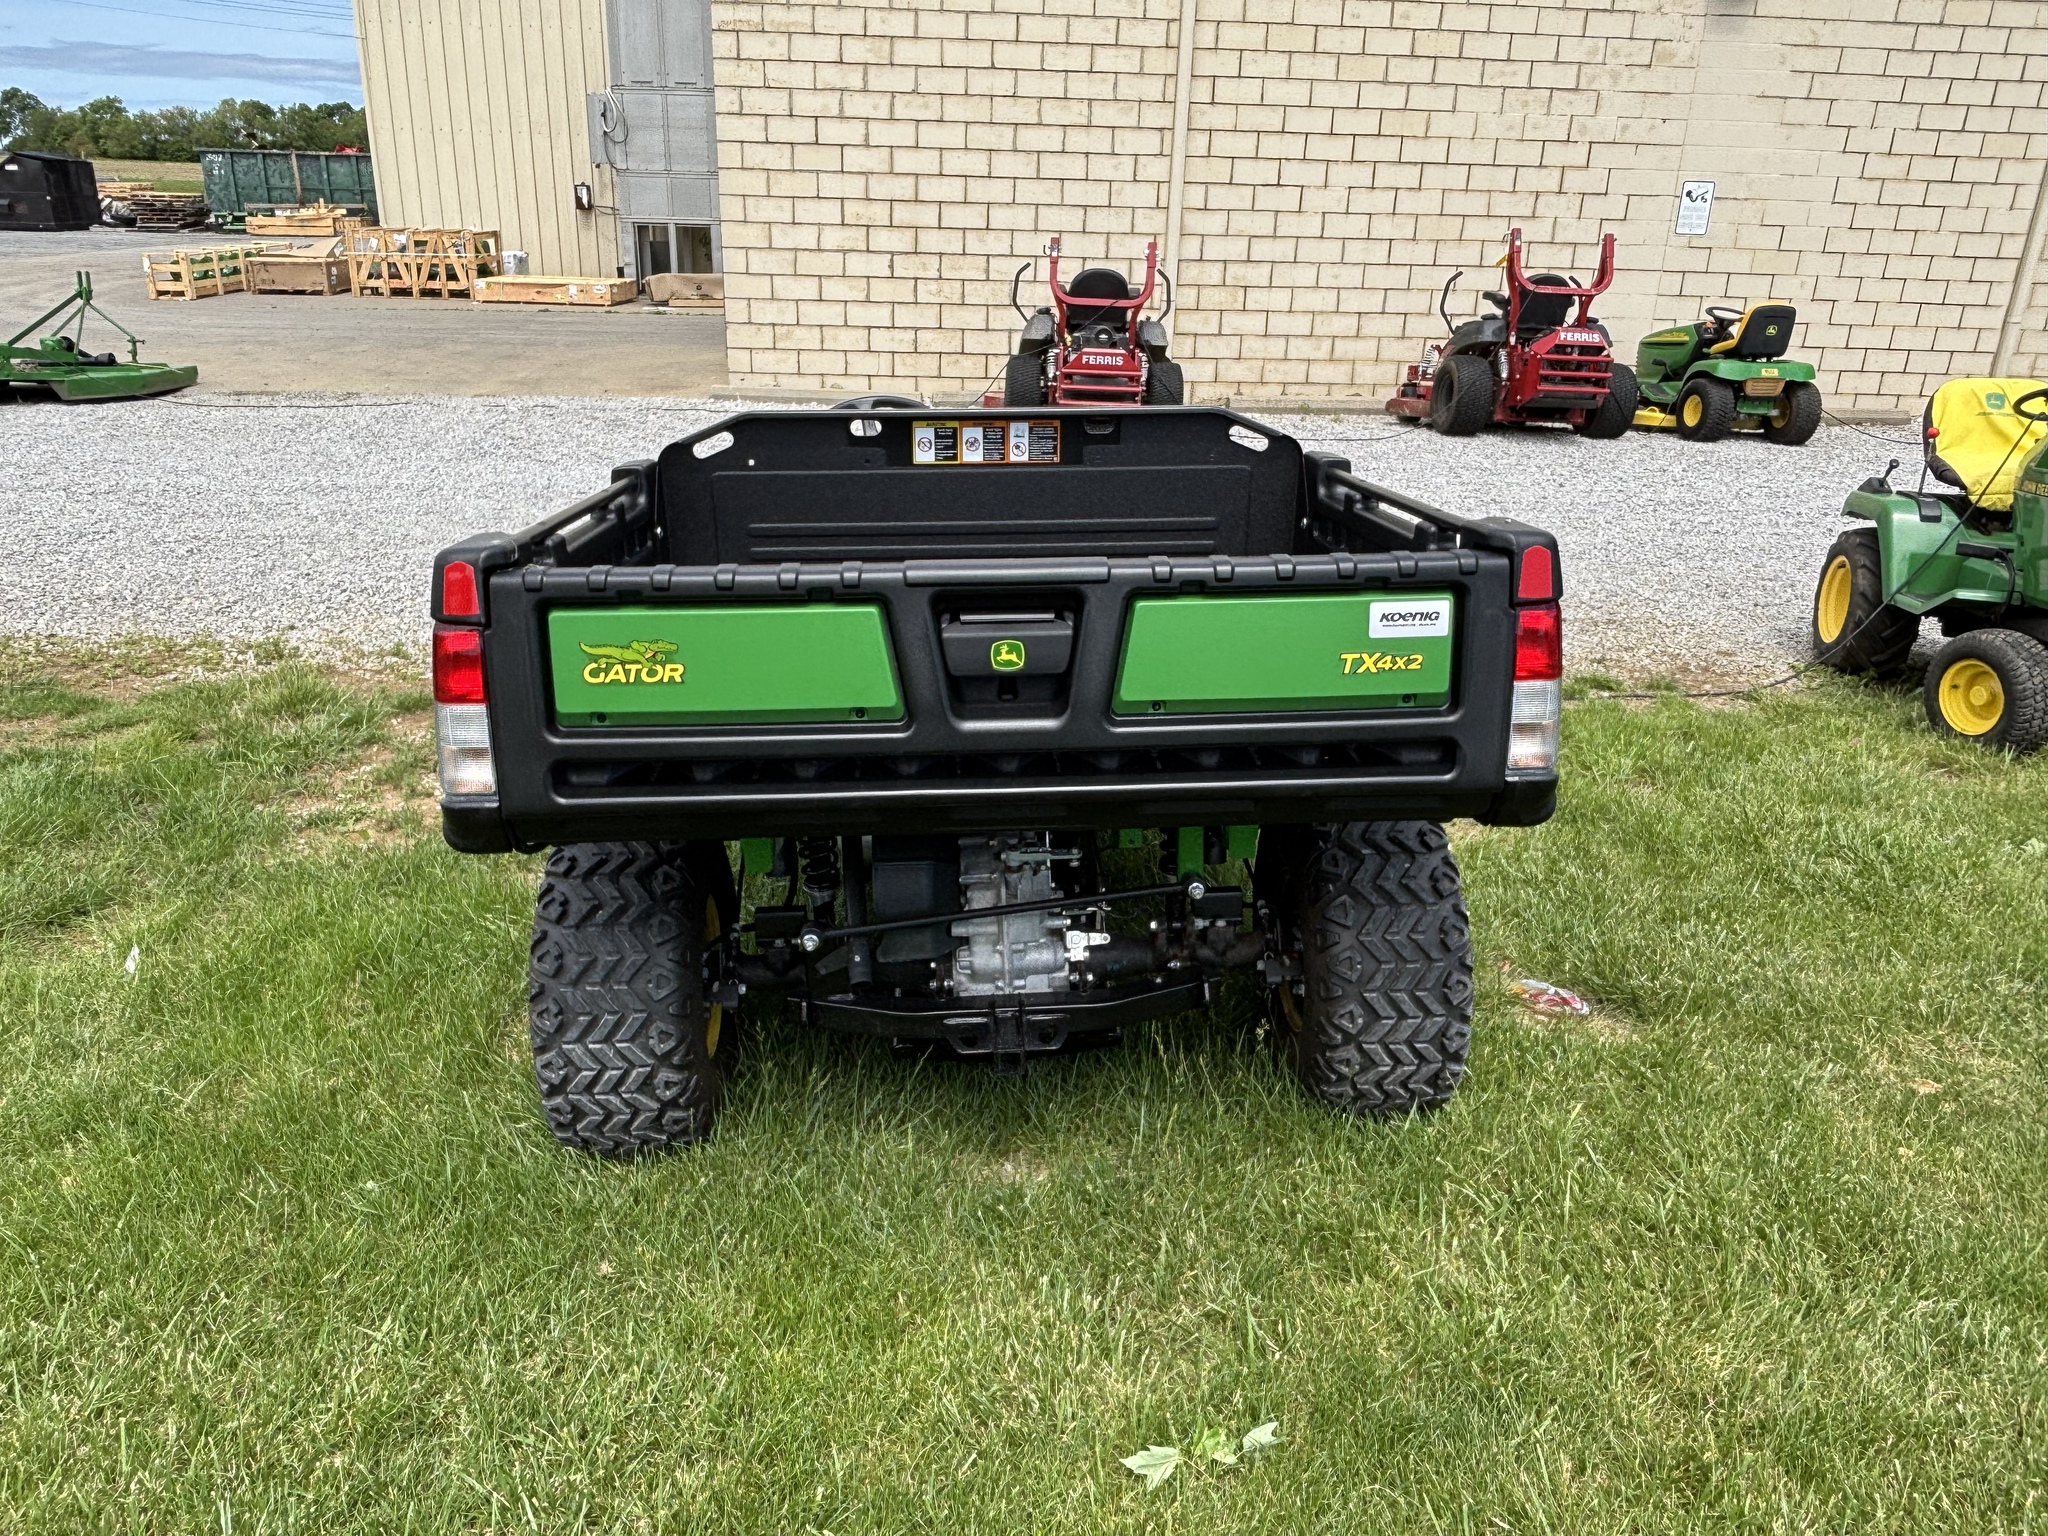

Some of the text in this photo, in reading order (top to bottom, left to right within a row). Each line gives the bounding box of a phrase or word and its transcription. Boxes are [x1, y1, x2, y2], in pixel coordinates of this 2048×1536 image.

[1560, 331, 1600, 342] FERRIS
[1082, 355, 1124, 366] FERRIS
[583, 662, 685, 684] GATOR
